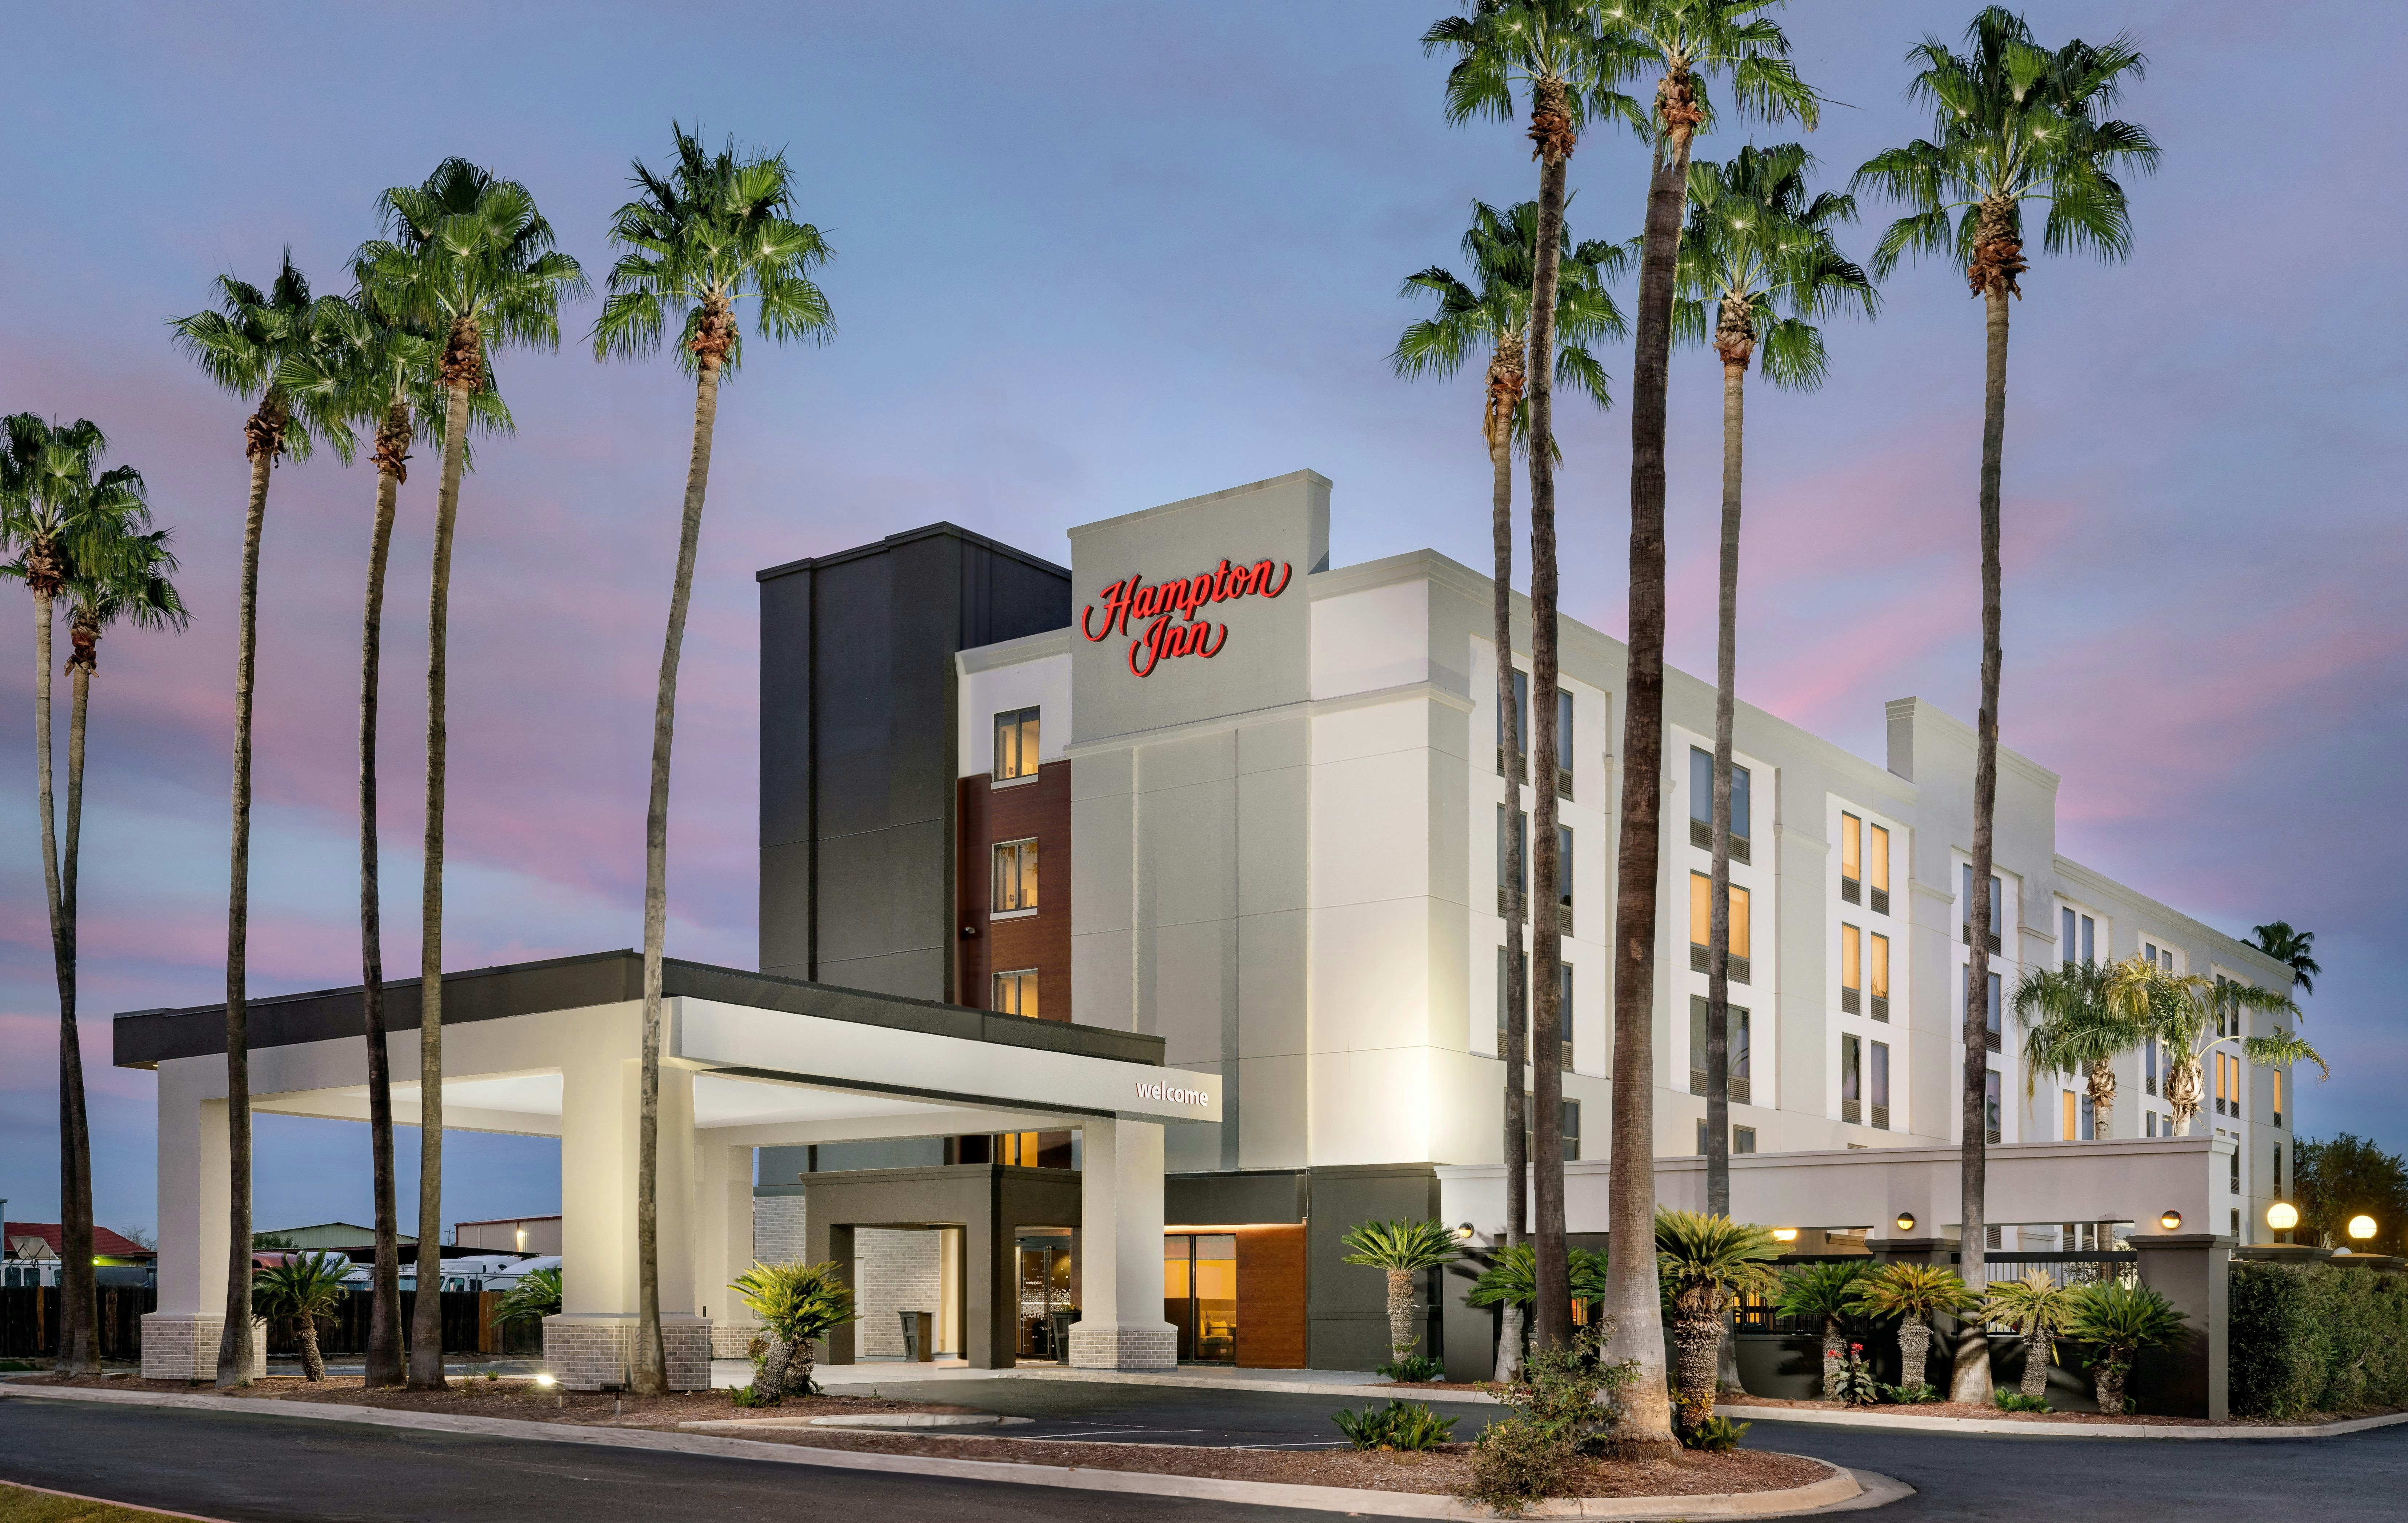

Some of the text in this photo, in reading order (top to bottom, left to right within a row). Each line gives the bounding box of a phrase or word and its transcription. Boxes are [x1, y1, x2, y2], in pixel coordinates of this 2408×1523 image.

[1081, 560, 1291, 642] Hampton
[1128, 615, 1227, 677] Inn
[1136, 1081, 1208, 1106] welcome
